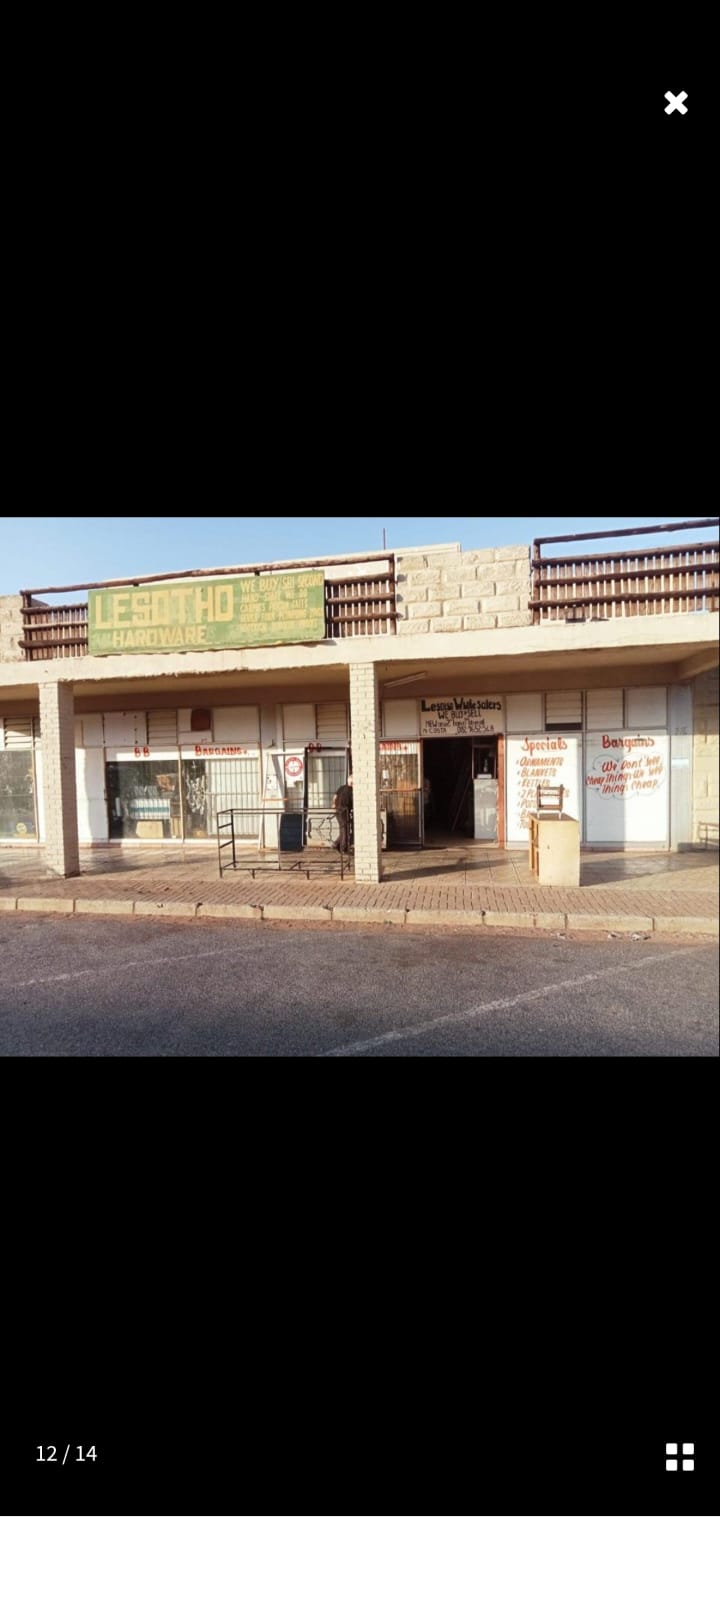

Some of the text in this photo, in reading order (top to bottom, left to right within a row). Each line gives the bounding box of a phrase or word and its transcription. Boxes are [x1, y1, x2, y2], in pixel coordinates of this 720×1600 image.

[240, 579, 256, 593] WE
[95, 585, 234, 629] LESOTHO
[112, 625, 207, 648] HARDWARE
[521, 736, 567, 756] Specials
[602, 734, 655, 752] Bargains
[602, 761, 617, 772] We
